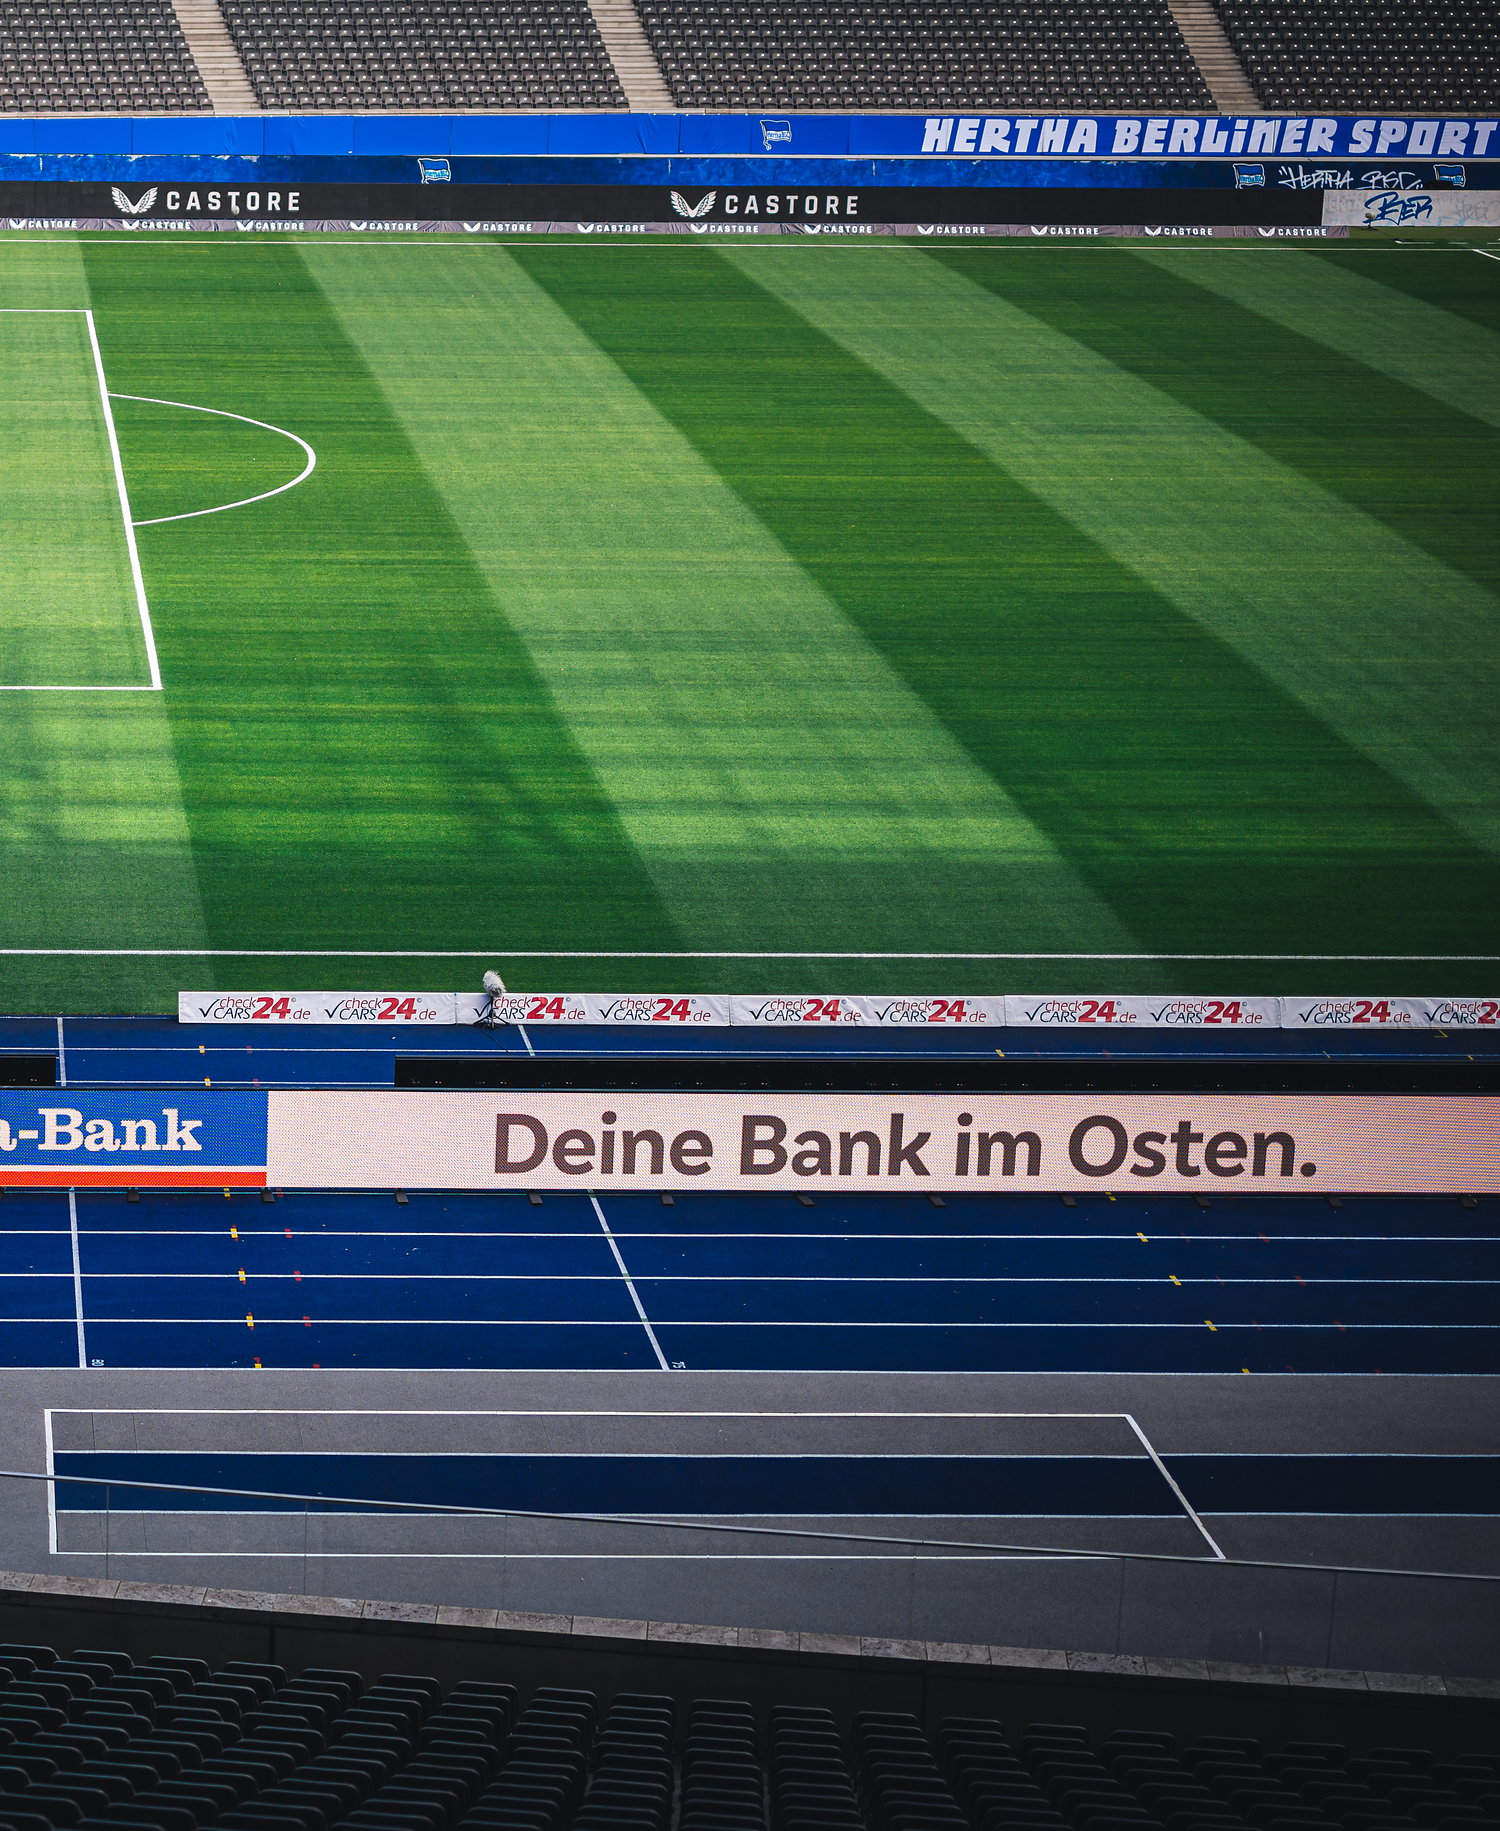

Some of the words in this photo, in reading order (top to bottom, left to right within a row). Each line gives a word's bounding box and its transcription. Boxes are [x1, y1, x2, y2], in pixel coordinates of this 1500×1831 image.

[921, 119, 1098, 153] HERTHA
[1349, 120, 1499, 155] SPORT
[166, 191, 300, 211] CASTORE
[725, 195, 859, 215] CASTORE
[27, 221, 77, 229] CASTORE
[141, 222, 191, 230] CASTORE
[255, 222, 304, 230] CASTORE
[368, 223, 418, 231] CASTORE
[482, 224, 532, 232] CASTORE
[596, 224, 645, 232] CASTORE
[709, 225, 759, 233] CASTORE
[823, 226, 872, 234] CASTORE
[937, 227, 986, 235] CASTORE
[1050, 227, 1100, 235] CASTORE
[1164, 228, 1213, 236] CASTORE
[1278, 229, 1327, 237] CASTORE
[219, 997, 256, 1008] check
[344, 998, 381, 1009] check
[494, 997, 530, 1008] check
[619, 999, 656, 1010] check
[770, 999, 806, 1010] check
[894, 1000, 931, 1012] check
[1044, 1001, 1081, 1012] check
[1170, 1002, 1207, 1013] check
[1320, 1002, 1356, 1013] check
[495, 1111, 712, 1176] Deine
[740, 1112, 931, 1177] Bank
[955, 1112, 1043, 1177] im
[1068, 1115, 1318, 1178] Osten.
